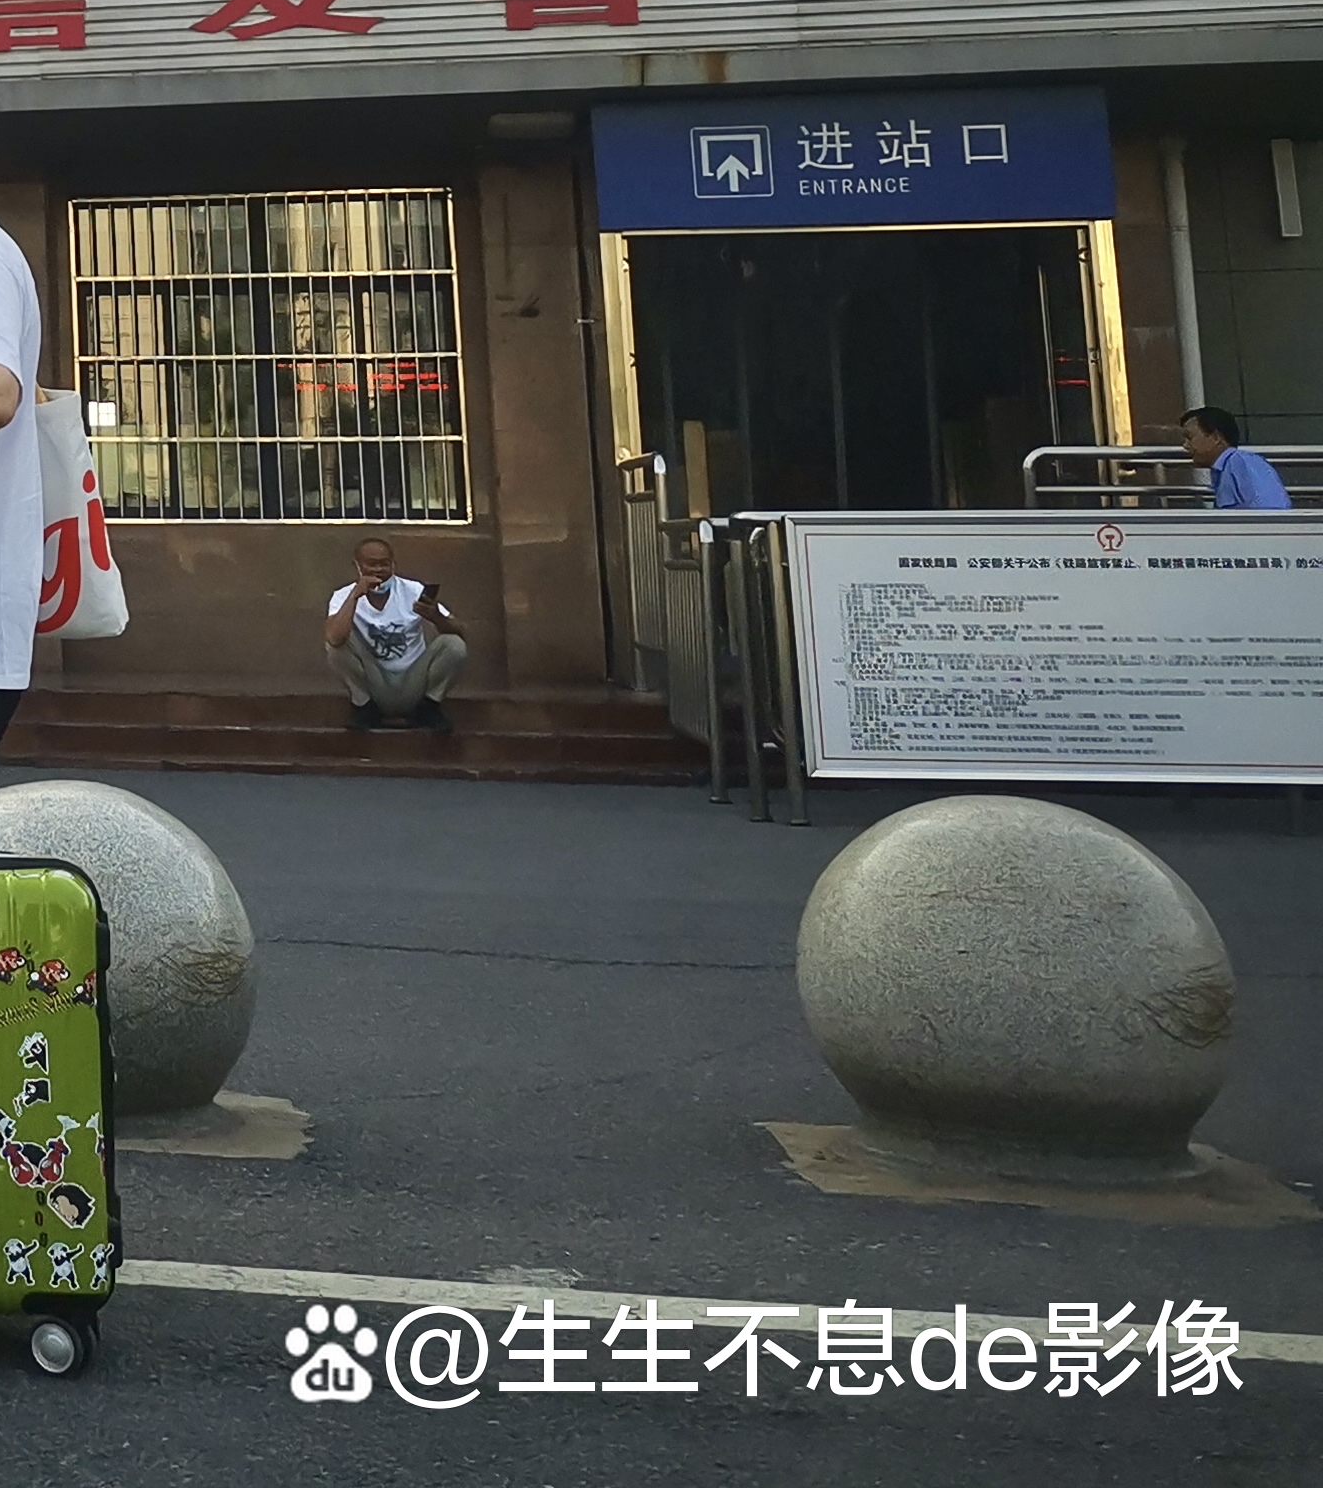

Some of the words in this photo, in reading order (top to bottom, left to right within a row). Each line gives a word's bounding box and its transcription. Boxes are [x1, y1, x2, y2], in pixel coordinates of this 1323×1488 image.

[797, 119, 1008, 170] 进站口
[800, 177, 911, 196] ENTRANCE
